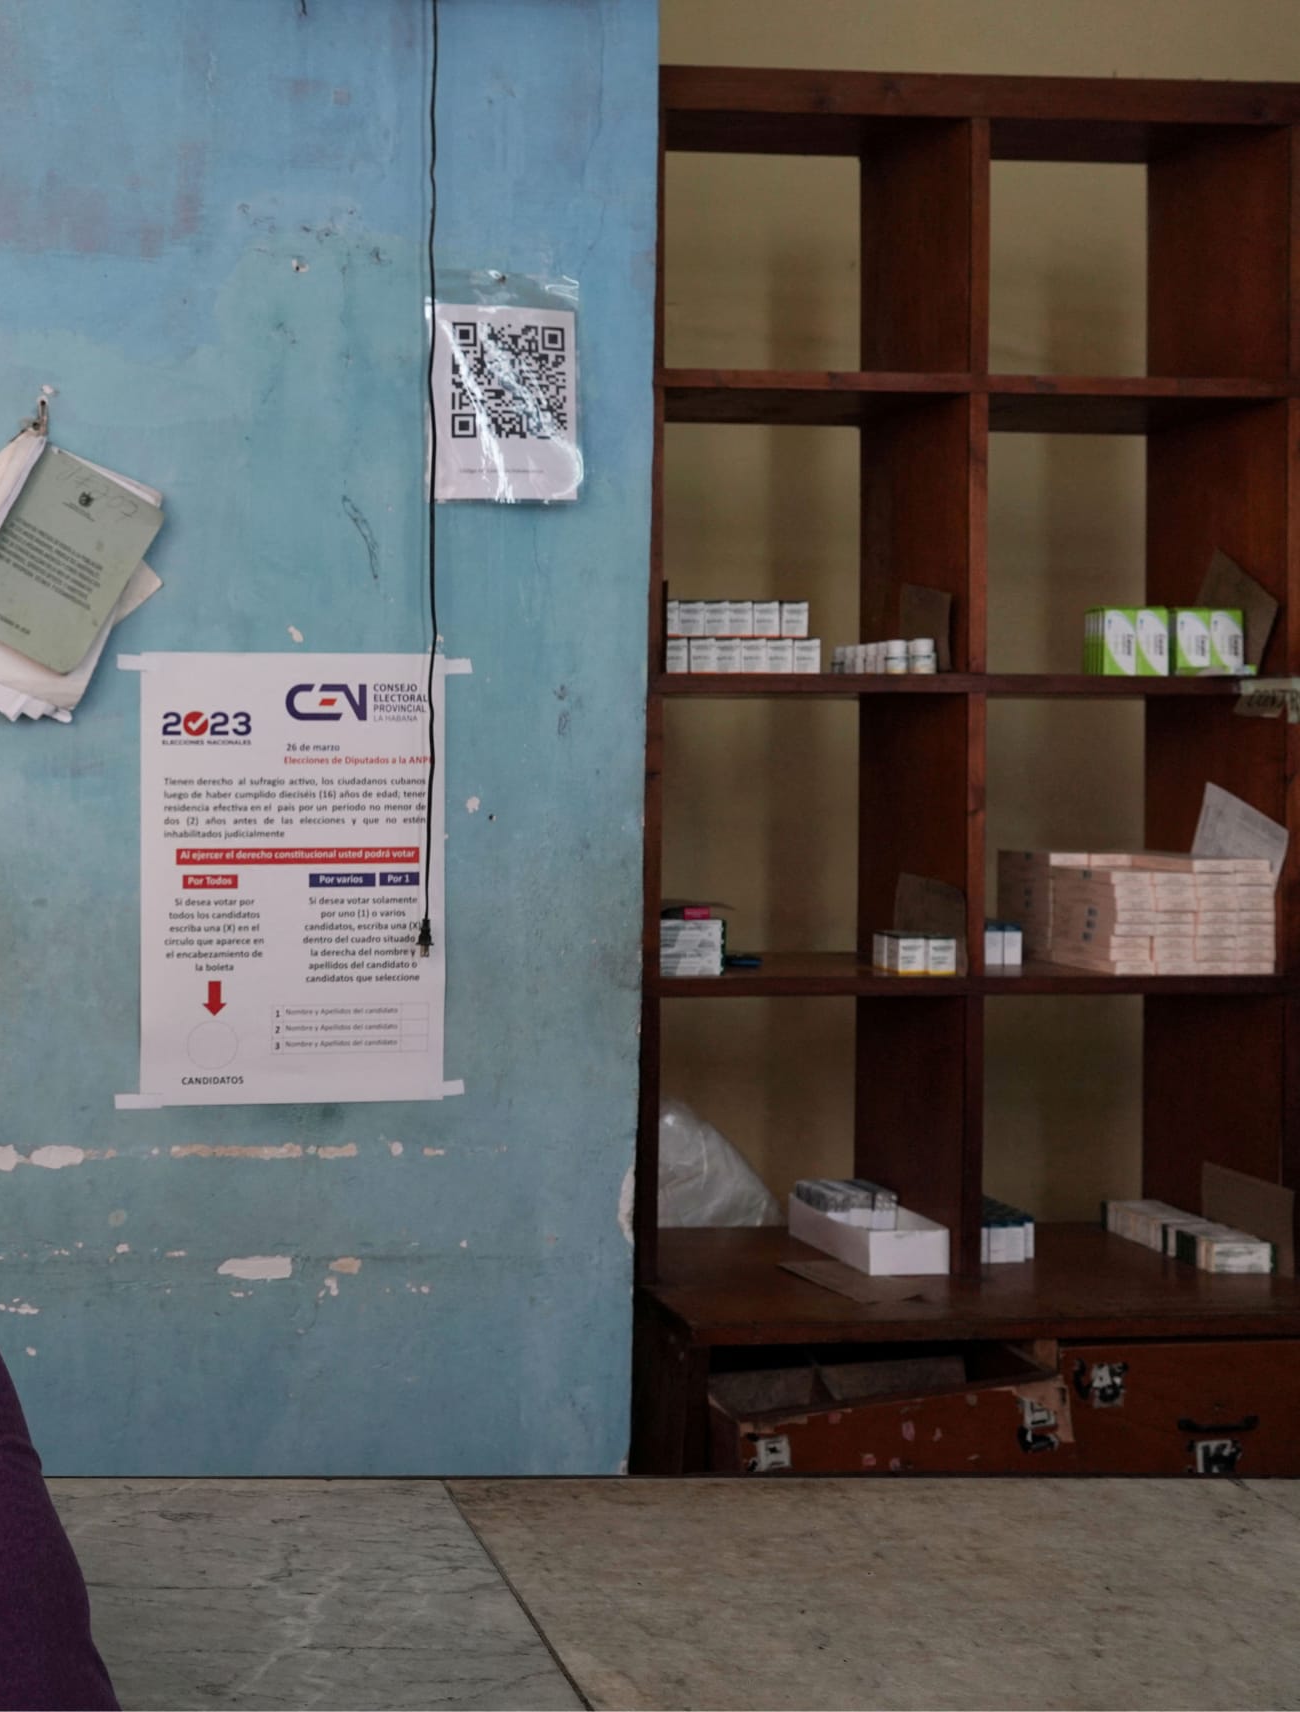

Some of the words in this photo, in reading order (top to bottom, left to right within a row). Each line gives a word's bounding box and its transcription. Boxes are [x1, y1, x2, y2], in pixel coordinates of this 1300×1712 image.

[374, 683, 417, 692] CONSEJO
[286, 684, 367, 721] CEN
[374, 694, 428, 702] ELECTORAL
[374, 704, 426, 712] PROVINCIAL
[287, 743, 297, 751] 26
[299, 743, 311, 751] de
[345, 756, 389, 766] Diputados
[399, 756, 406, 764] la
[409, 756, 431, 764] ANP
[250, 778, 284, 787] sufragio
[289, 778, 318, 786] activo,
[164, 791, 188, 800] luego
[191, 791, 201, 799] de
[206, 791, 231, 799] haber
[235, 791, 276, 800] cumplido
[319, 790, 336, 799] (16)
[164, 804, 209, 812] residencia
[213, 804, 247, 812] efectiva
[164, 817, 179, 825] dos
[187, 817, 199, 826] (2)
[206, 817, 226, 825] años
[264, 817, 274, 825] de
[281, 817, 293, 825] las
[403, 816, 425, 824] estén
[164, 830, 222, 838] inhabilitados
[224, 830, 284, 840] judicialmente
[181, 850, 190, 858] Al
[192, 850, 224, 861] ejercer
[227, 849, 233, 858] el
[236, 849, 272, 858] derecho
[275, 848, 336, 858] constitucional
[339, 849, 362, 858] usted
[364, 848, 390, 860] podrá
[393, 849, 415, 858] votar
[188, 877, 203, 886] Por
[205, 877, 232, 886] Todos
[319, 875, 333, 884] Por
[336, 875, 363, 884] varios
[388, 875, 402, 883] Por
[404, 875, 409, 883] 1
[321, 911, 335, 919] por
[358, 910, 369, 918] (1)
[223, 924, 235, 933] (X)
[177, 950, 249, 958] encabezamiento
[374, 948, 408, 956] nombre
[309, 962, 348, 970] apellidos
[356, 976, 372, 984] que
[320, 1008, 351, 1016] Apellidos
[320, 1024, 351, 1032] Apellidos
[320, 1040, 351, 1048] Apellidos
[182, 1076, 244, 1085] CANDIDATOS
